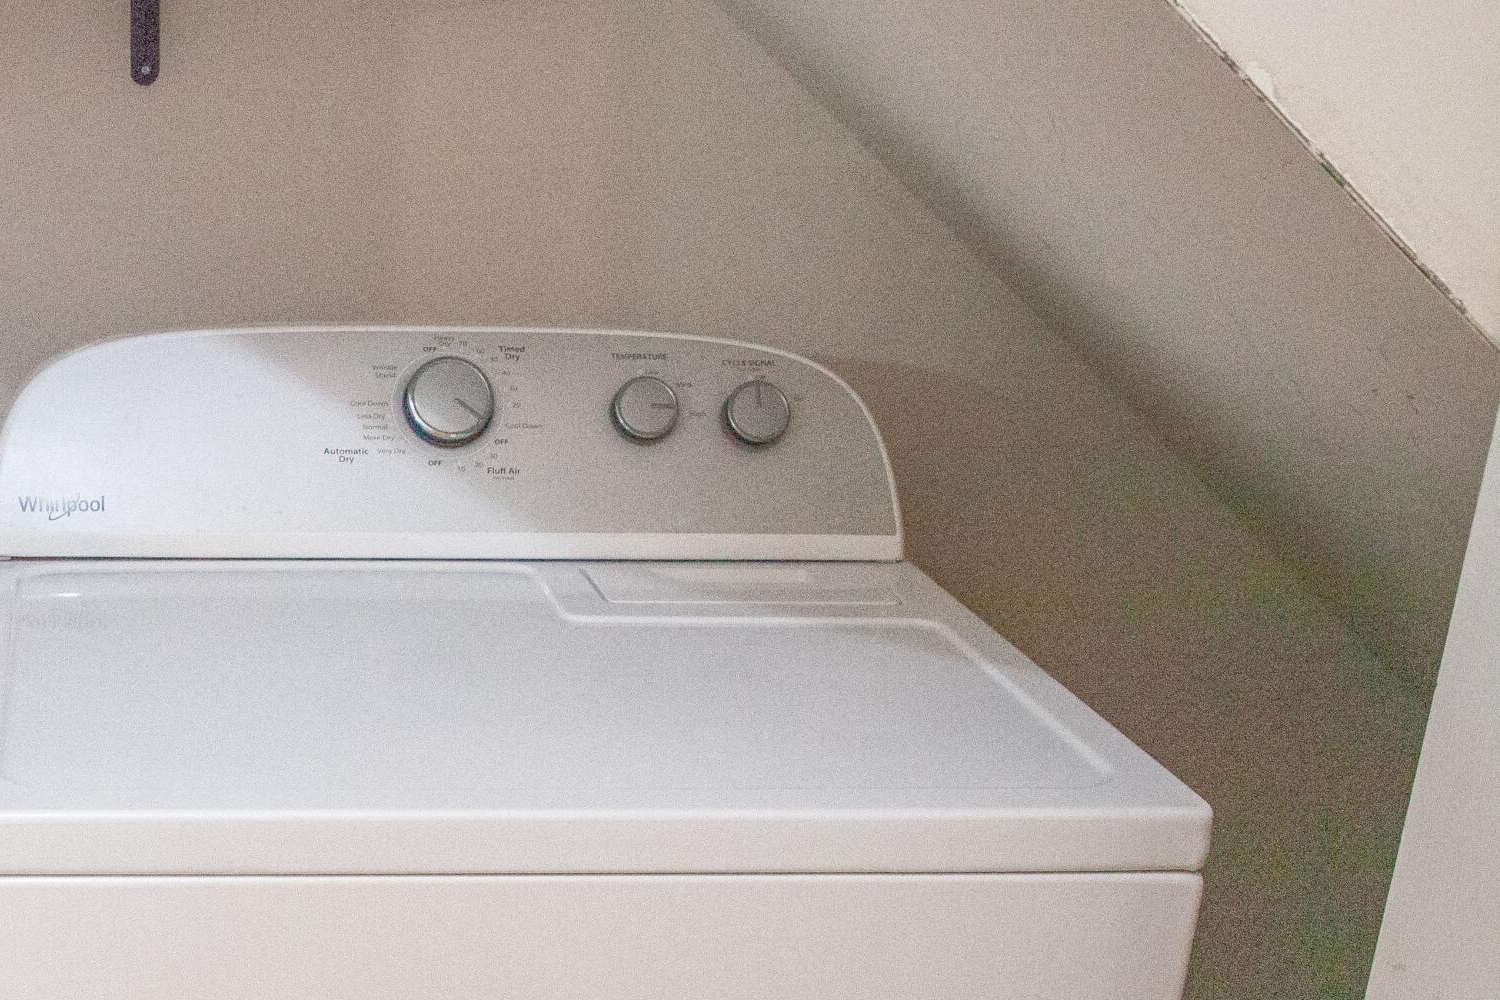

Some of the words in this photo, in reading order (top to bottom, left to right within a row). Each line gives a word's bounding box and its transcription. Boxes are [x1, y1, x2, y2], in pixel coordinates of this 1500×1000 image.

[498, 345, 526, 353] Timed
[505, 353, 520, 361] Dry
[323, 447, 369, 455] Automatic
[338, 455, 355, 464] Dry
[487, 467, 506, 475] Fluff
[18, 493, 105, 520] Whirlpool
